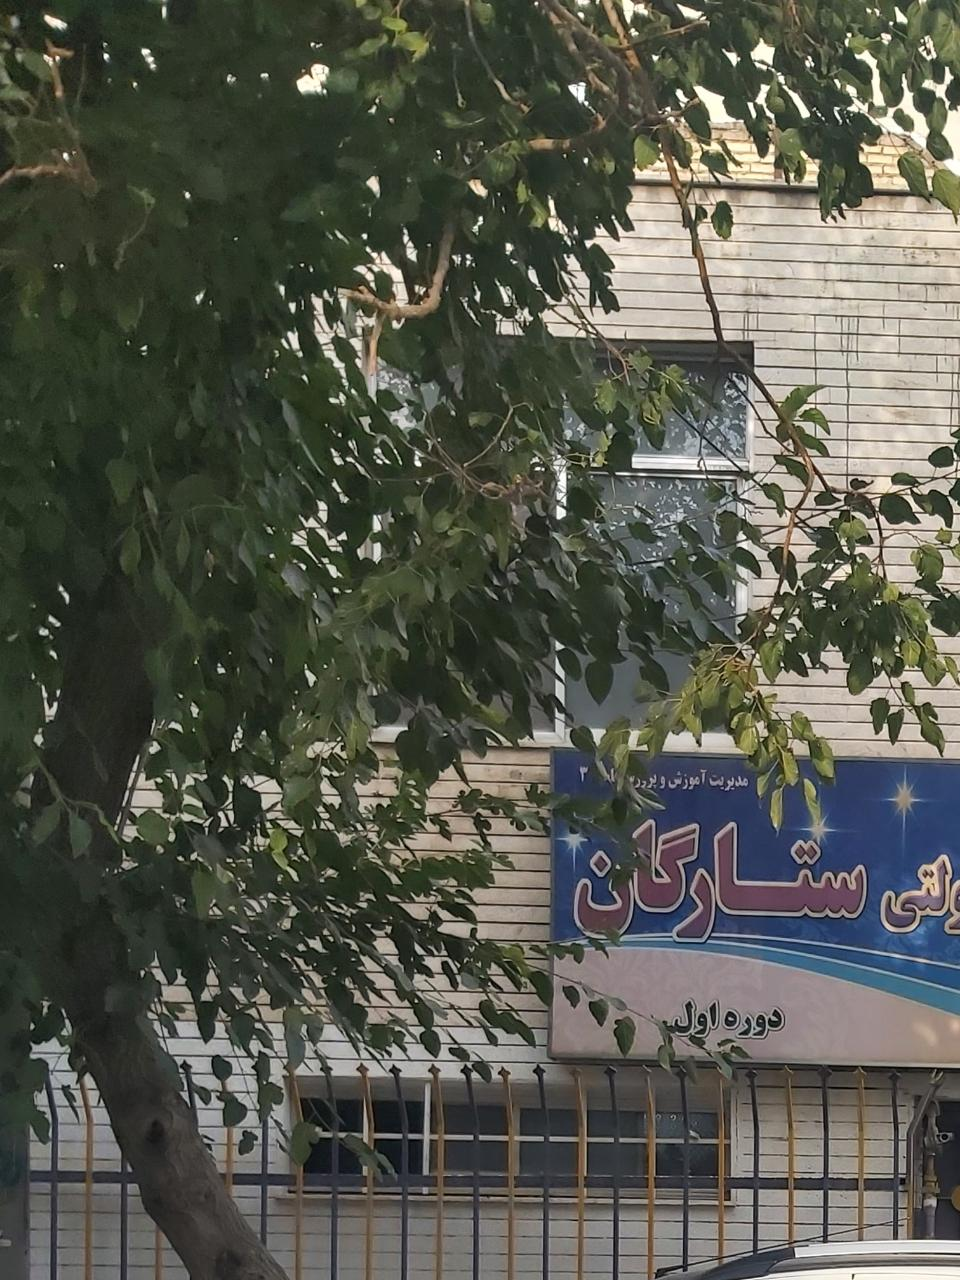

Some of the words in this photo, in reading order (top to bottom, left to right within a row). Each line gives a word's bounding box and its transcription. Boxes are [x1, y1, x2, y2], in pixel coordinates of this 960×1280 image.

[659, 775, 666, 789] و
[667, 769, 707, 789] آموزش
[709, 773, 749, 791] مدیریت
[573, 819, 867, 943] ستارگان
[672, 999, 720, 1037] اول
[723, 1007, 785, 1039] دوره
